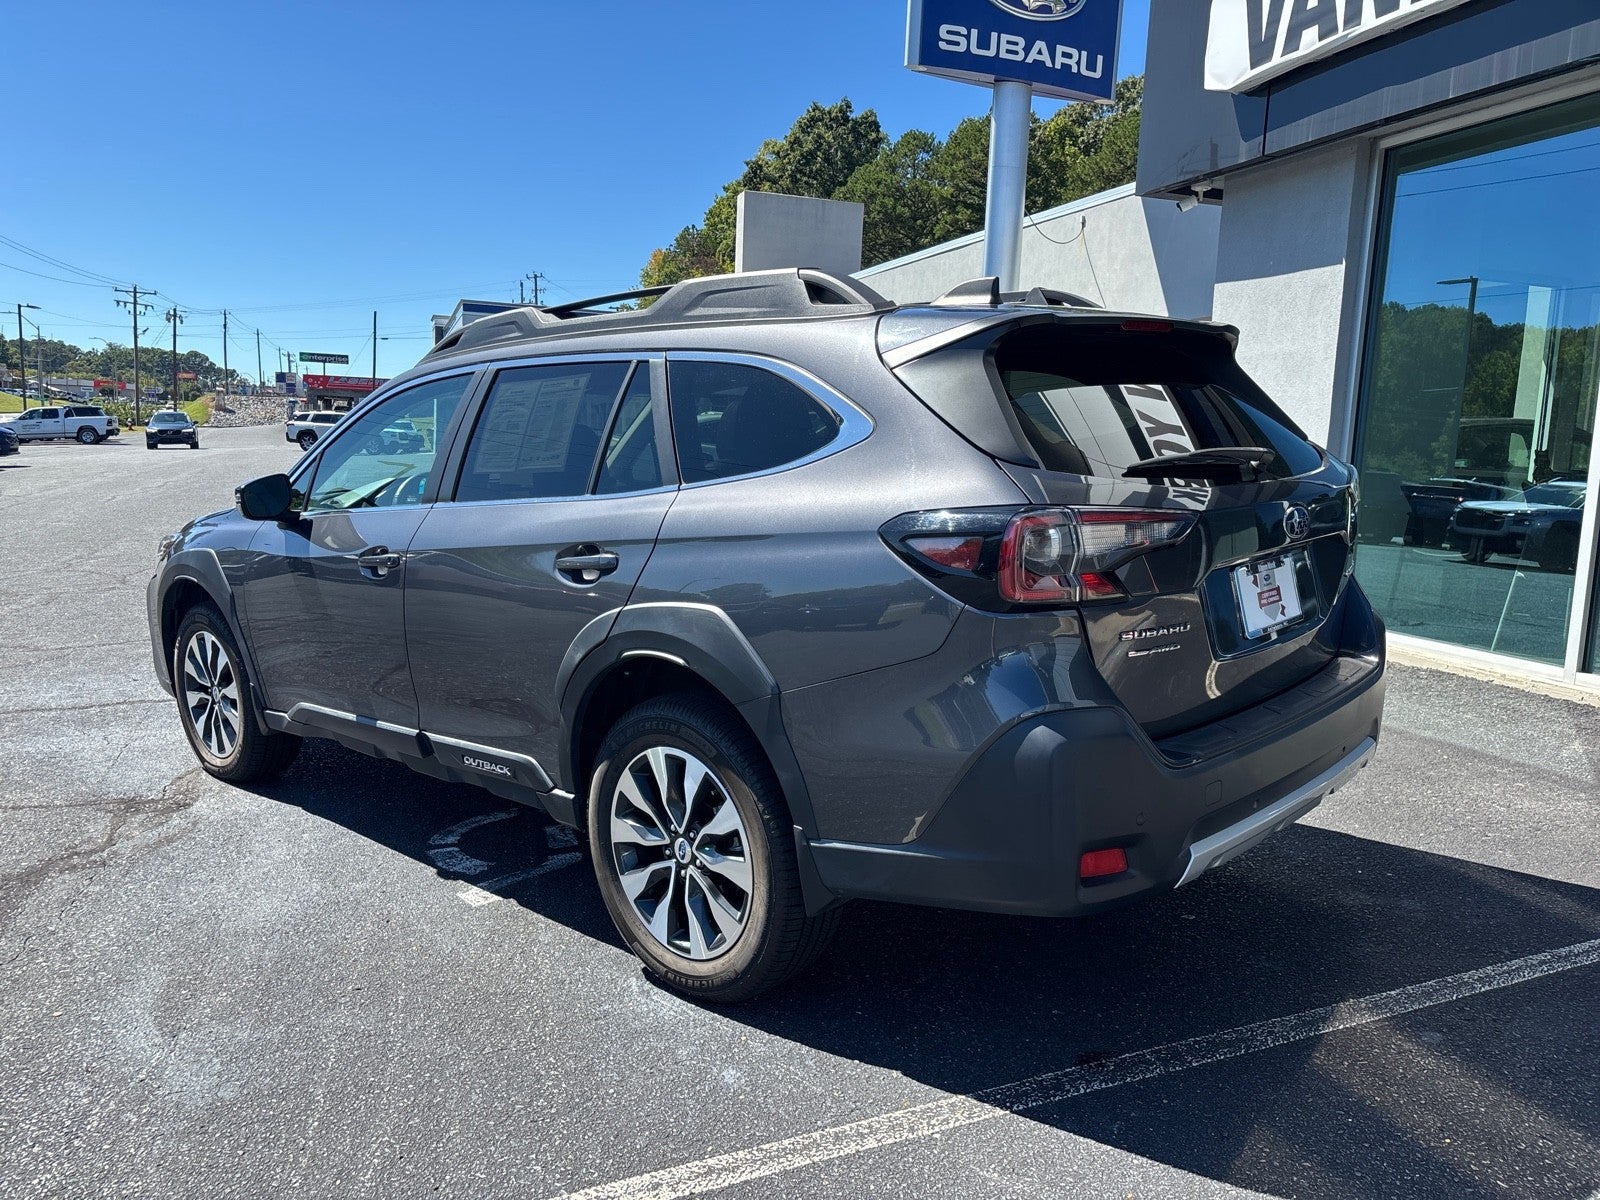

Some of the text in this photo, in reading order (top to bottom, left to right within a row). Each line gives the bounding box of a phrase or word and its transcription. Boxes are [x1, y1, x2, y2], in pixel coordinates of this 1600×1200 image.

[938, 23, 1104, 80] SUBARU
[302, 353, 348, 363] enterprise
[1120, 624, 1191, 641] SUBARU
[625, 721, 678, 738] MICHELIN
[463, 756, 511, 776] OUTBACK
[667, 972, 720, 987] MICHELIN
